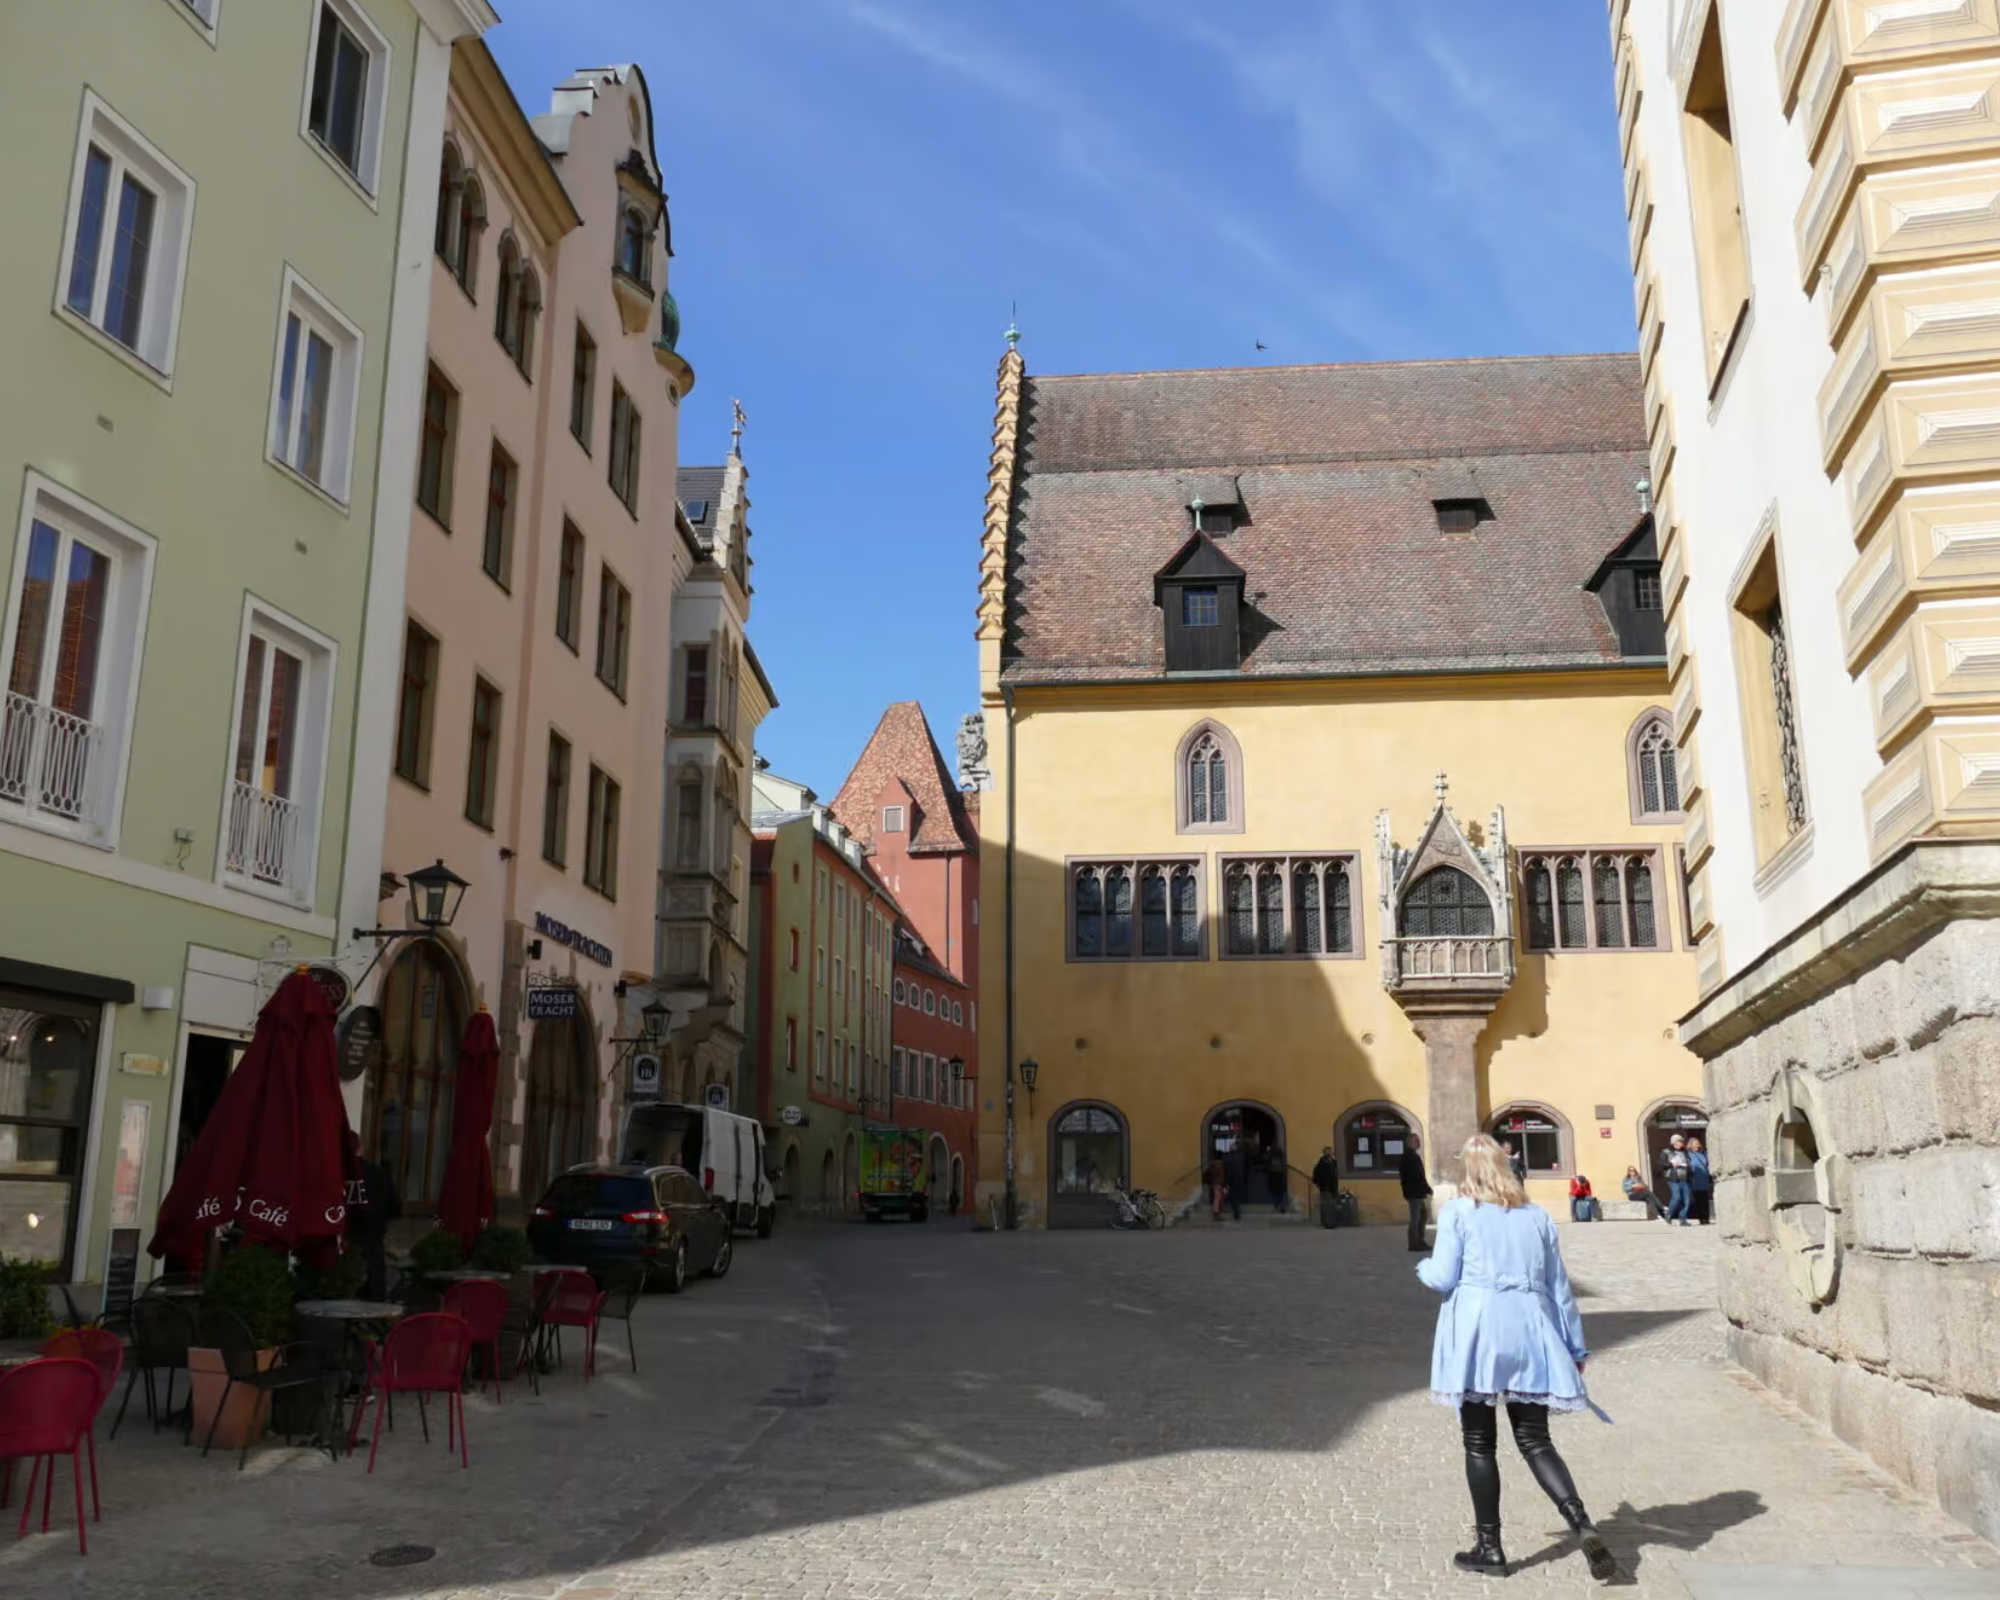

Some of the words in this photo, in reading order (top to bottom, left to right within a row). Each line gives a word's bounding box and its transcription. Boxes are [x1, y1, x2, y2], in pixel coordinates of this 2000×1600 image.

[529, 993, 574, 1005] MOSER
[529, 1005, 575, 1017] TRACHT
[249, 1199, 289, 1227] Café
